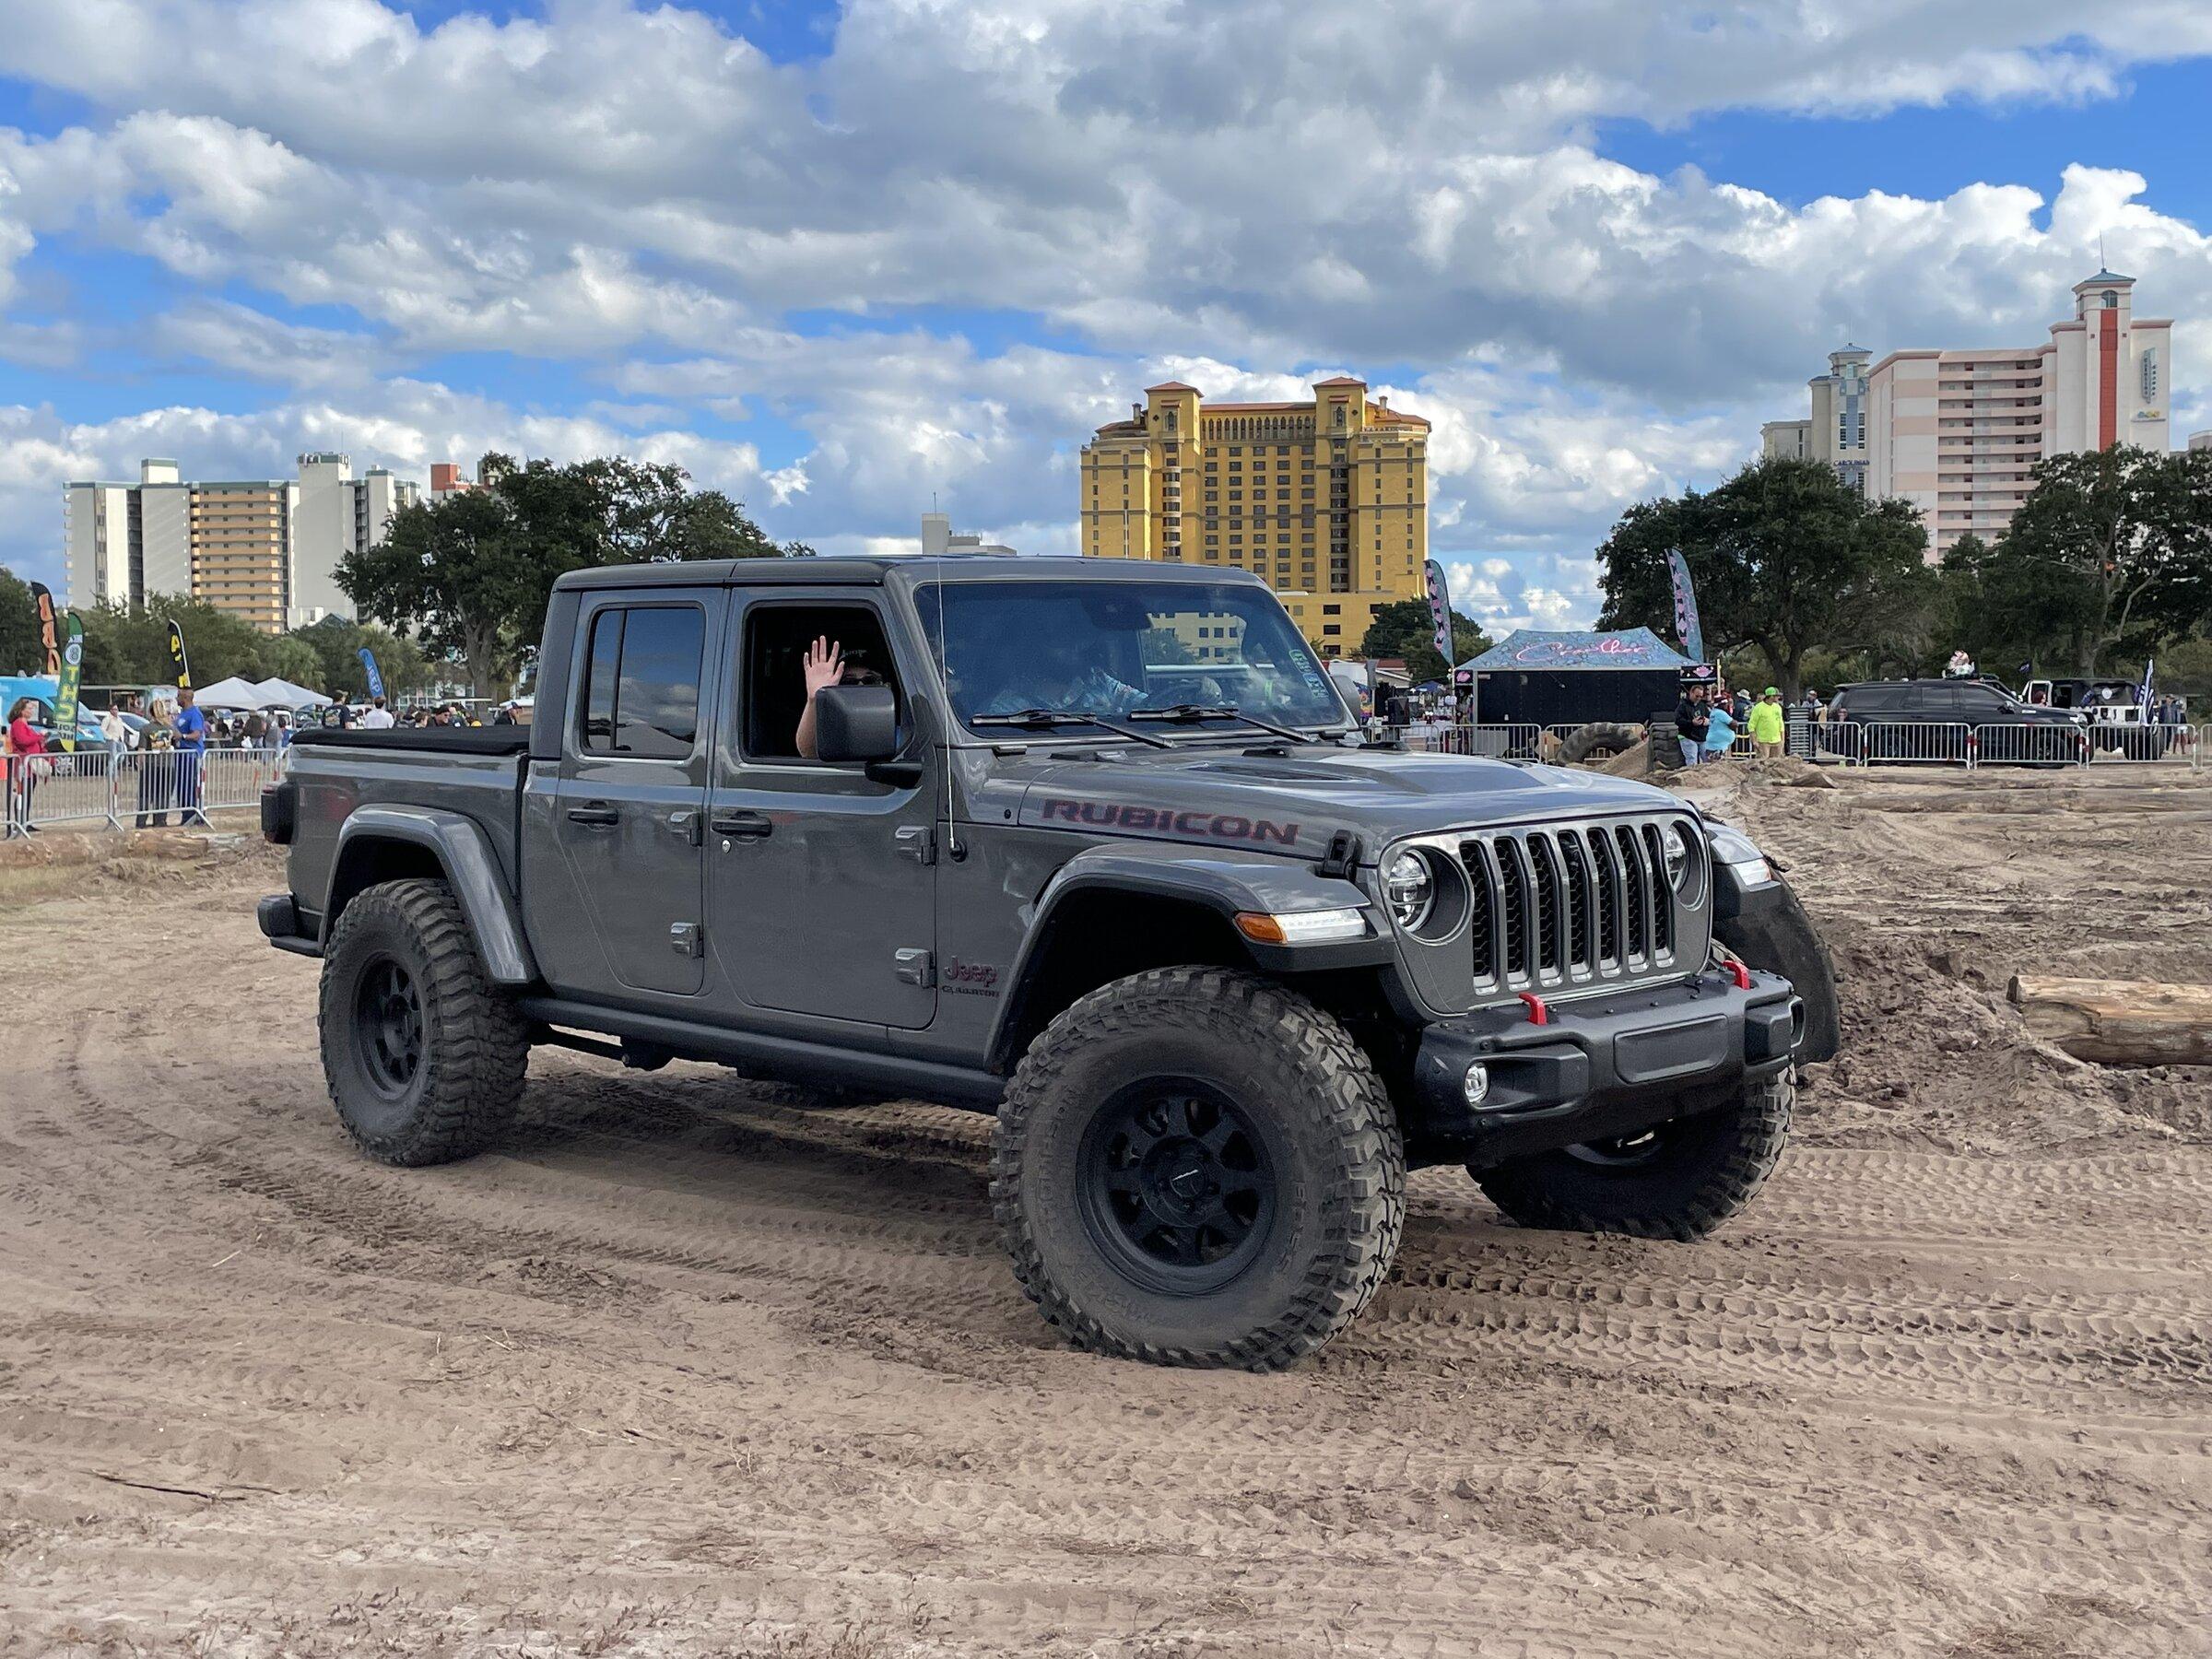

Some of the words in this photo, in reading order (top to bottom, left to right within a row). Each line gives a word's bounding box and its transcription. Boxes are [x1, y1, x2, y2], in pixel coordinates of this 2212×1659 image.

[367, 665, 381, 692] JEEP
[1041, 798, 1300, 846] RUBICON
[944, 955, 998, 988] Jeep
